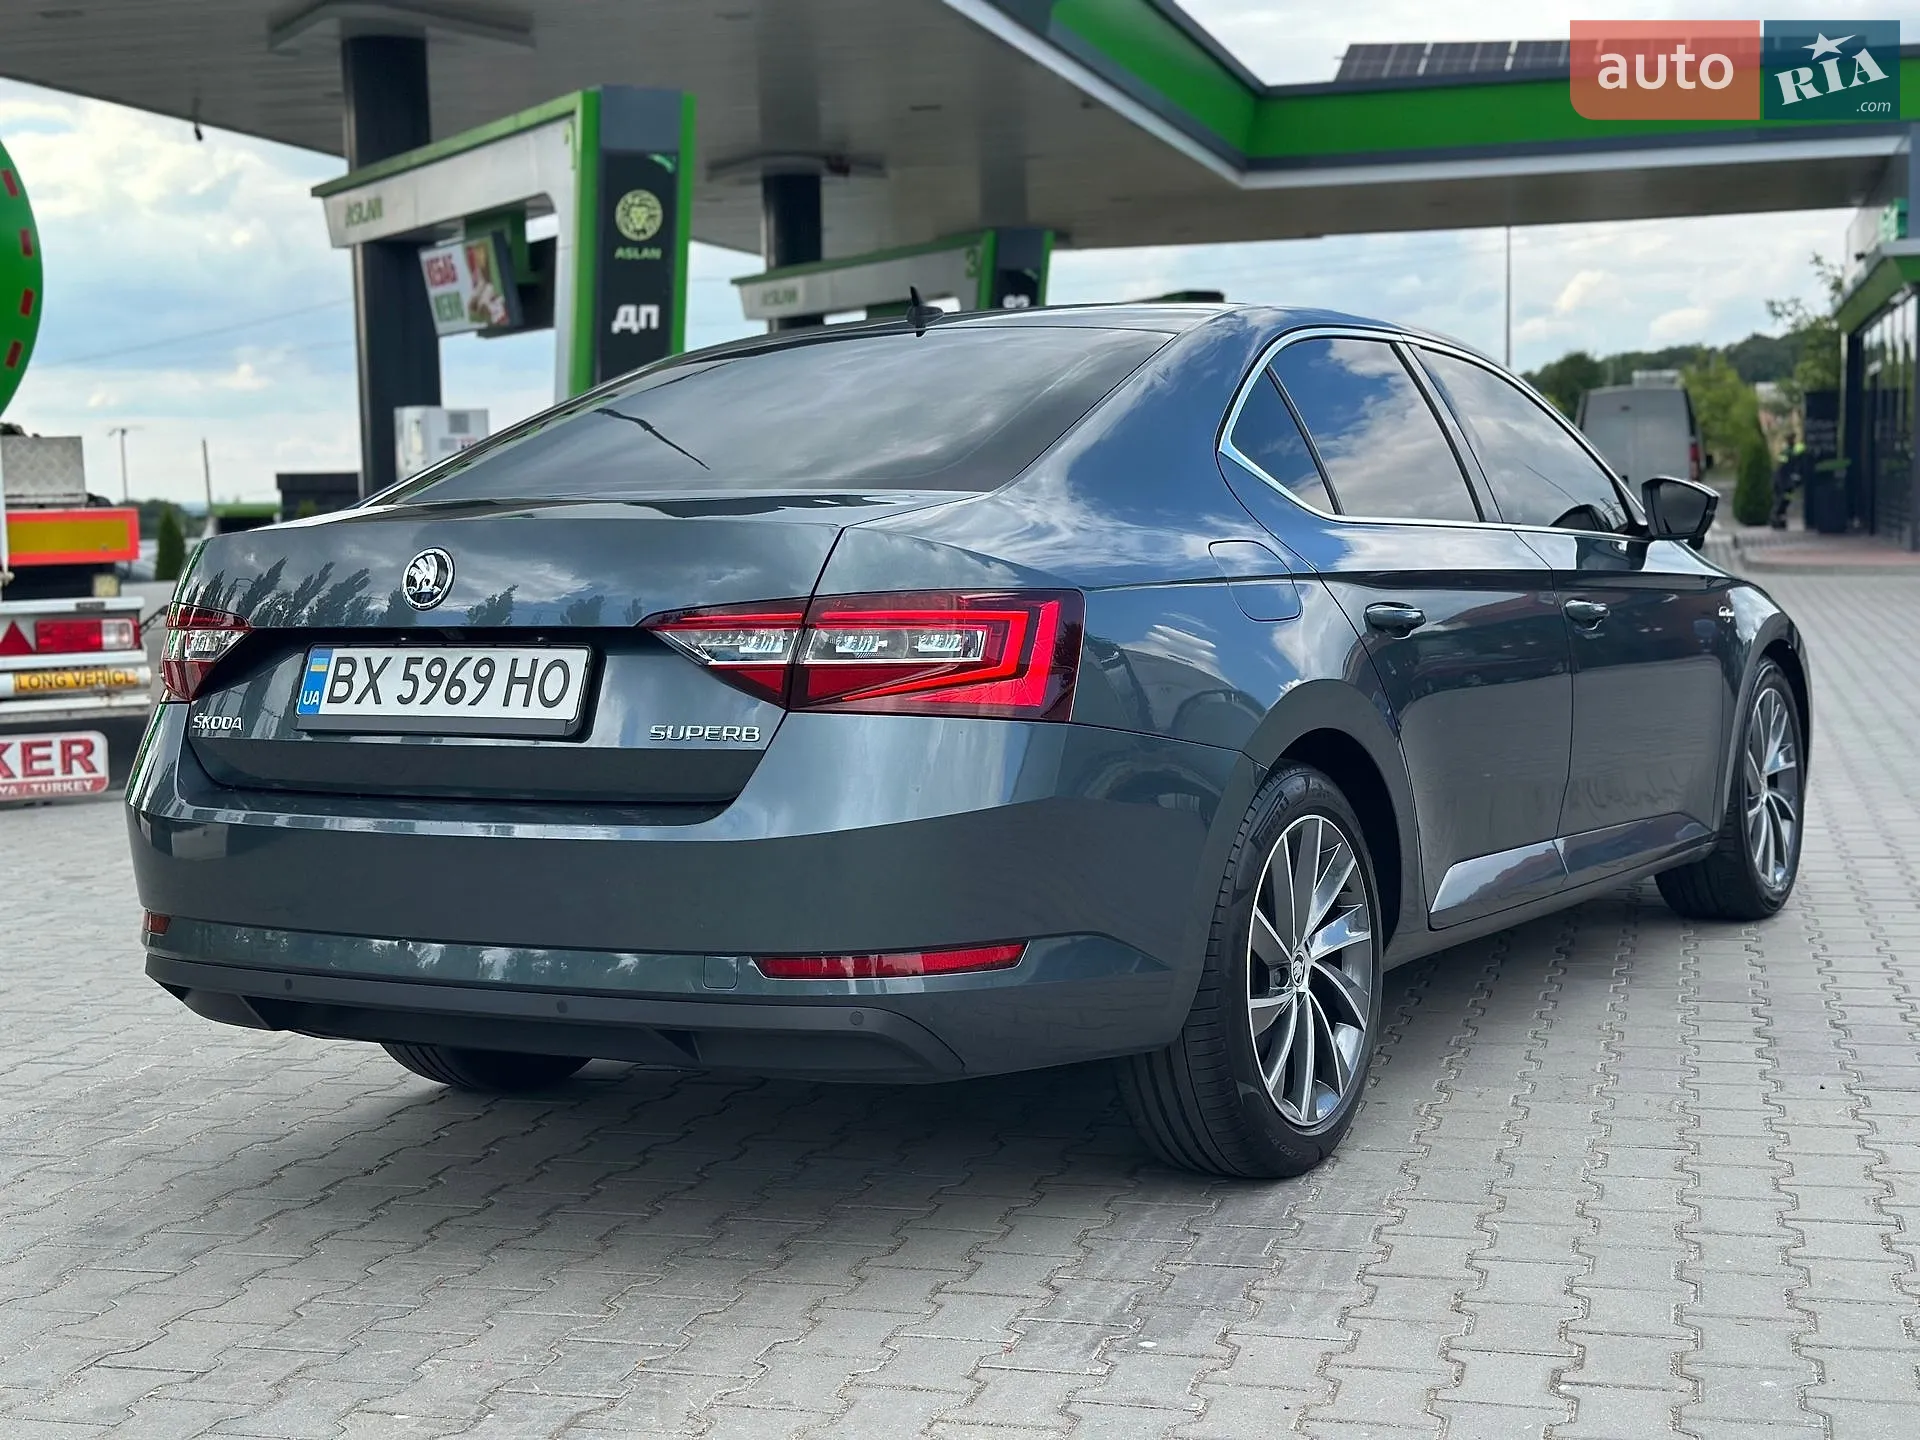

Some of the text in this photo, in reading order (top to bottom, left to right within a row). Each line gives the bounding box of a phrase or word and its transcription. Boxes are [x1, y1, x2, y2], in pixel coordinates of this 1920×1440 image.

[615, 248, 662, 260] ASLAN
[612, 304, 659, 334] ДП
[18, 673, 66, 690] LONG
[327, 656, 570, 709] BX 5969 HO
[303, 690, 321, 706] UA
[192, 713, 243, 731] ŠKODA
[649, 723, 761, 743] SUPERB
[30, 780, 93, 793] TURKEY
